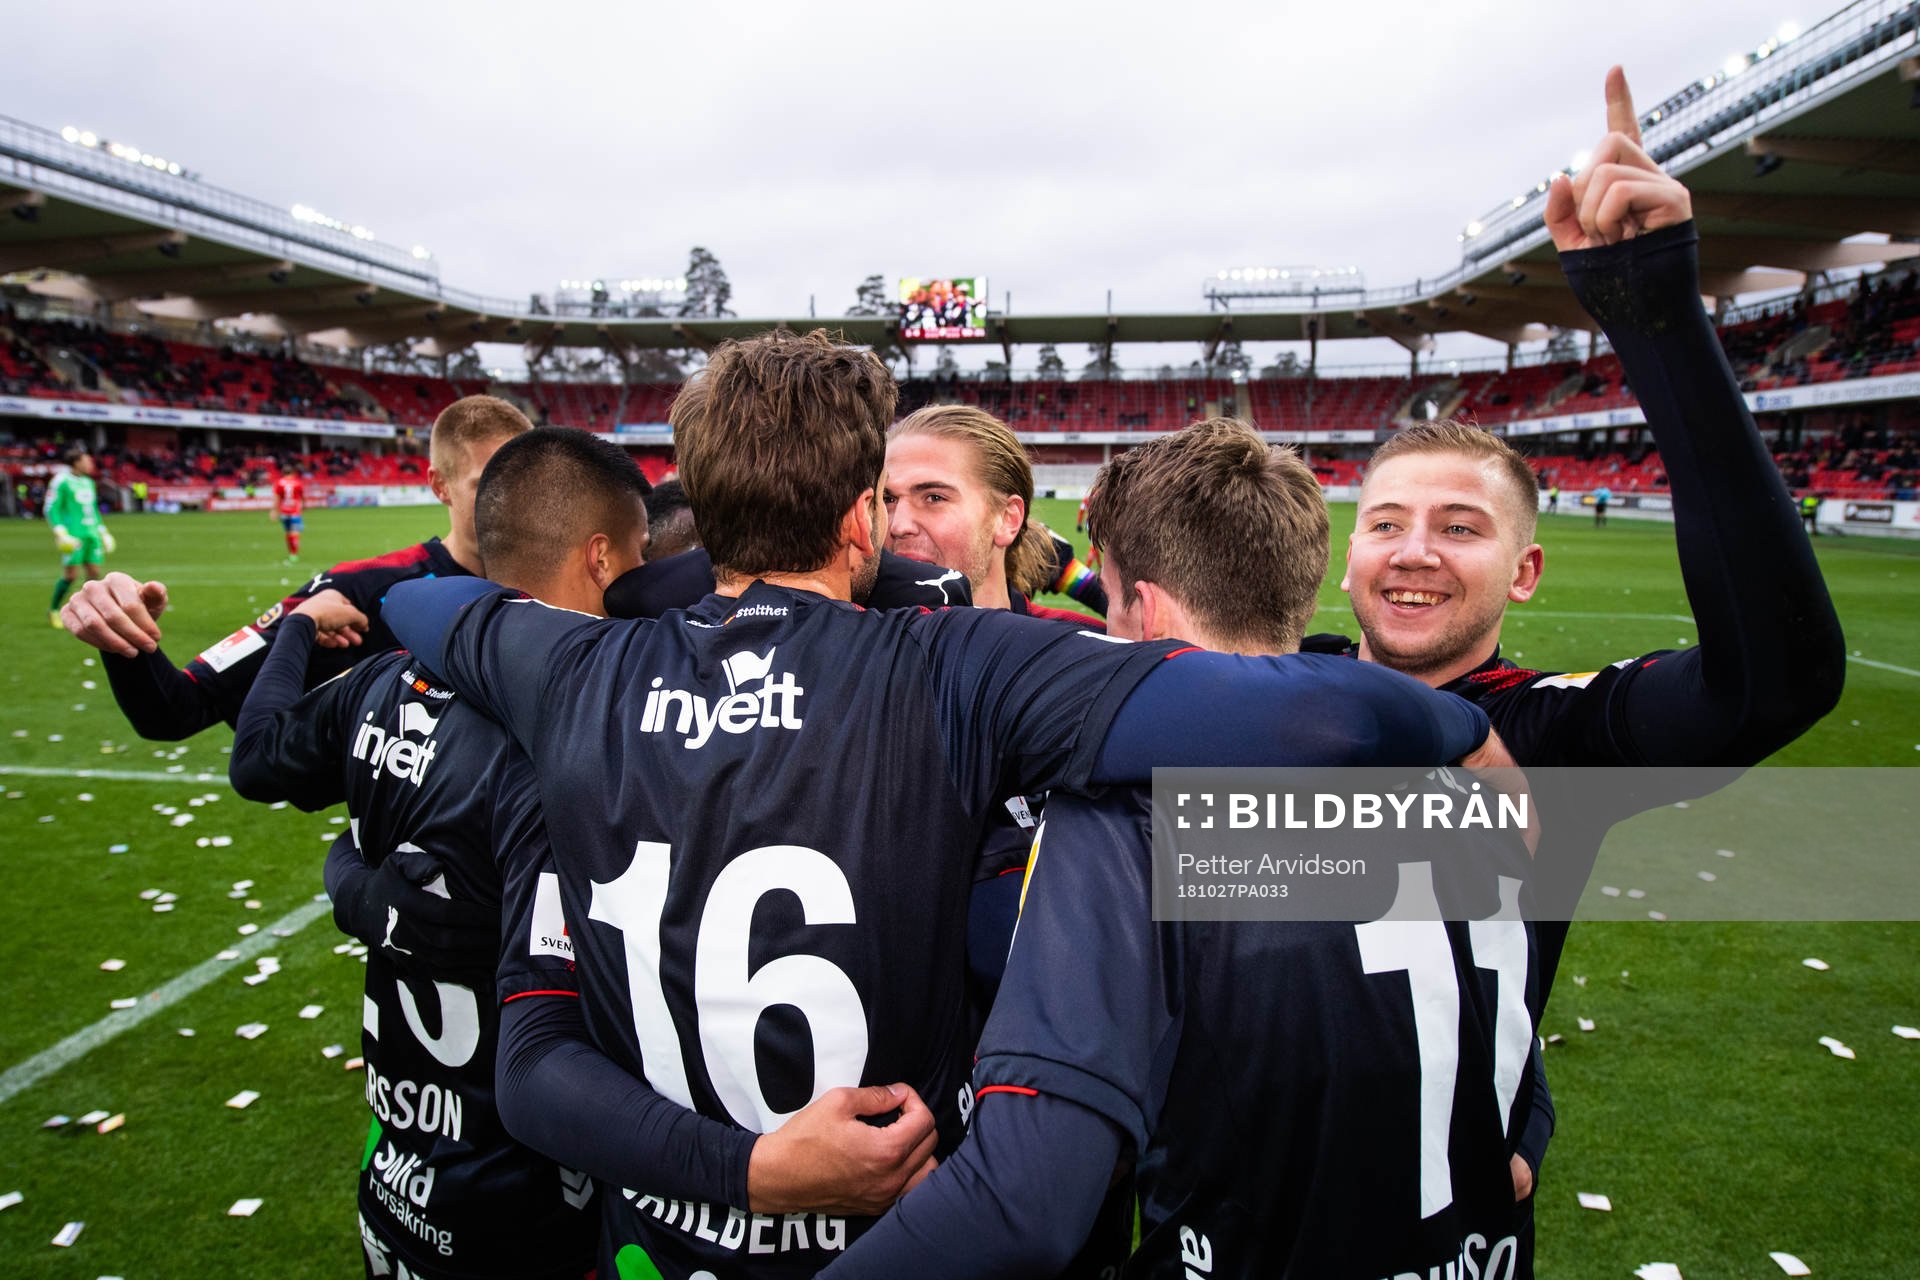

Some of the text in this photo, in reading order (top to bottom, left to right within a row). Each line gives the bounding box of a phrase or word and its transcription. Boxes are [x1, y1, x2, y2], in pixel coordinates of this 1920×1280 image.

[353, 710, 437, 788] inyett
[640, 672, 804, 750] inyett
[541, 936, 575, 952] SVEN
[588, 841, 869, 1135] 16
[1354, 861, 1533, 1220] 11
[365, 1062, 462, 1142] RSSON
